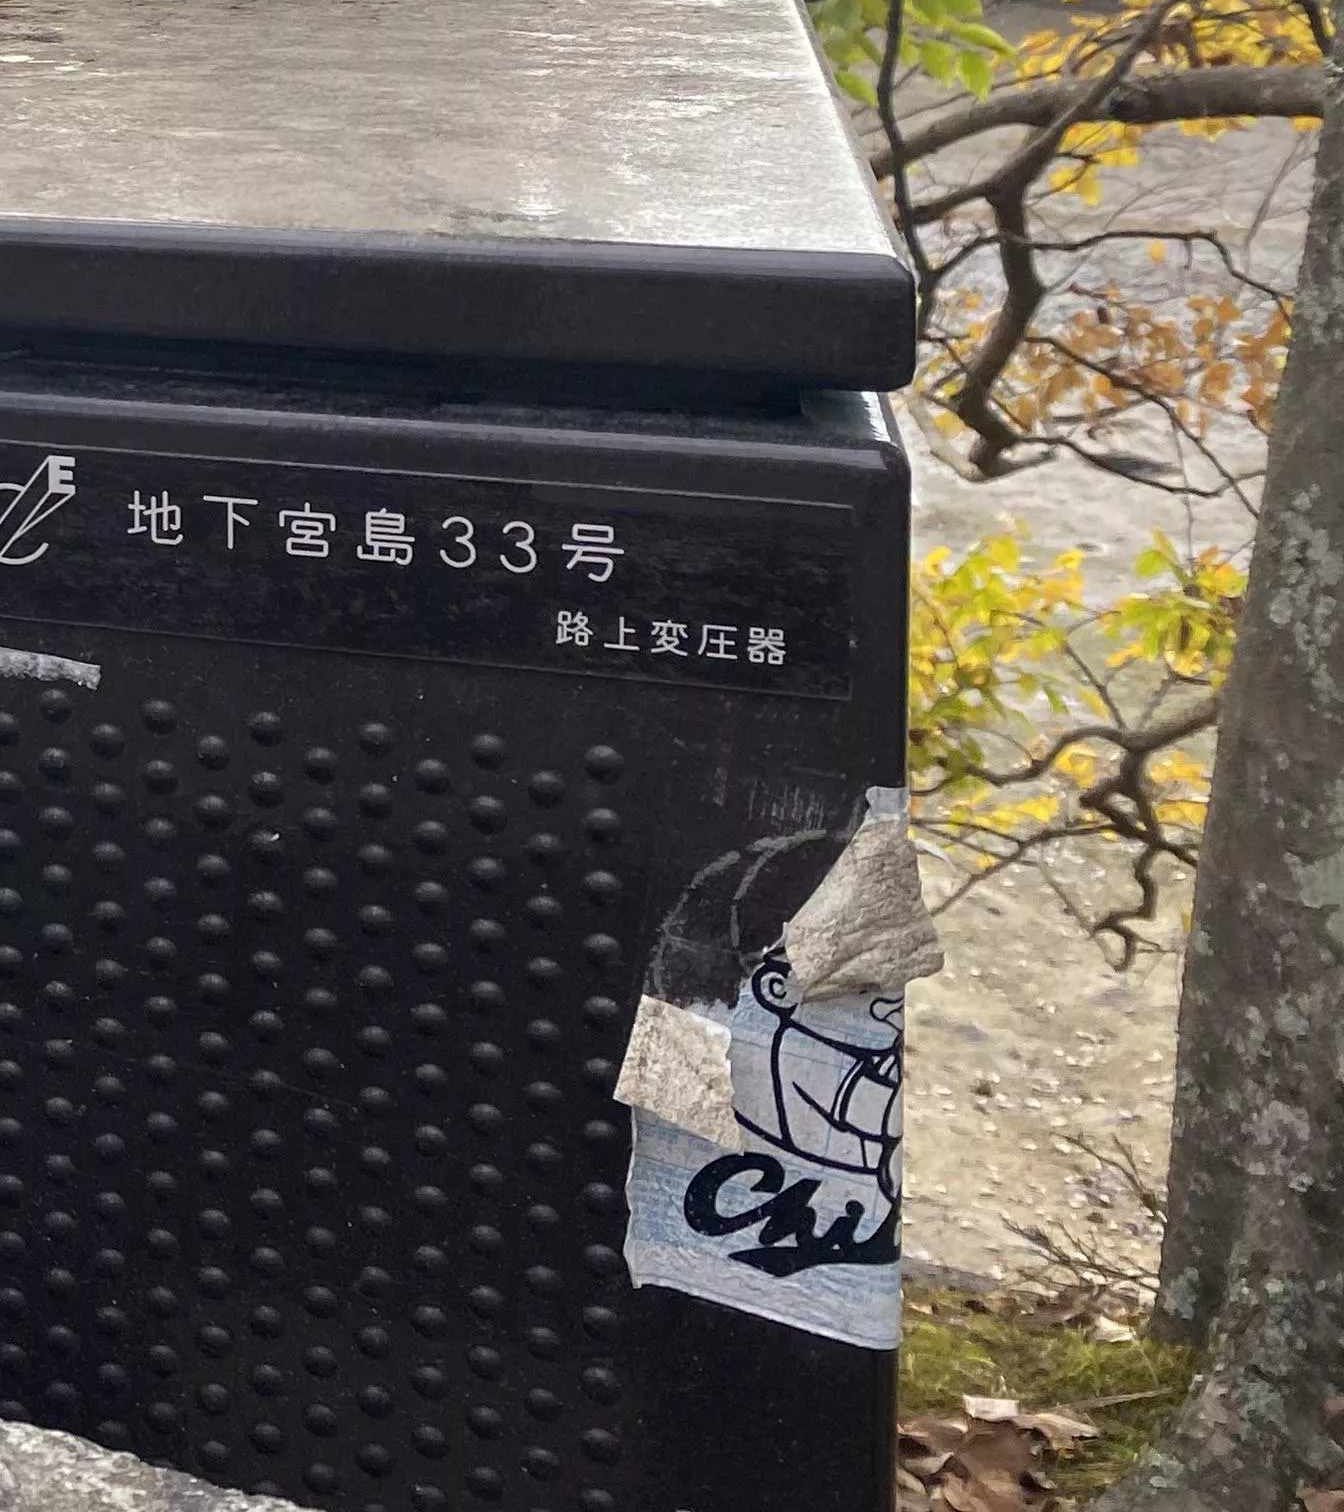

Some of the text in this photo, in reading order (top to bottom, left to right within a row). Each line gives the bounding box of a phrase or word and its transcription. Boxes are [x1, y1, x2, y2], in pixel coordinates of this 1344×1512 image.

[127, 490, 625, 583] 地下宮島33号
[555, 612, 787, 667] 路上変圧器
